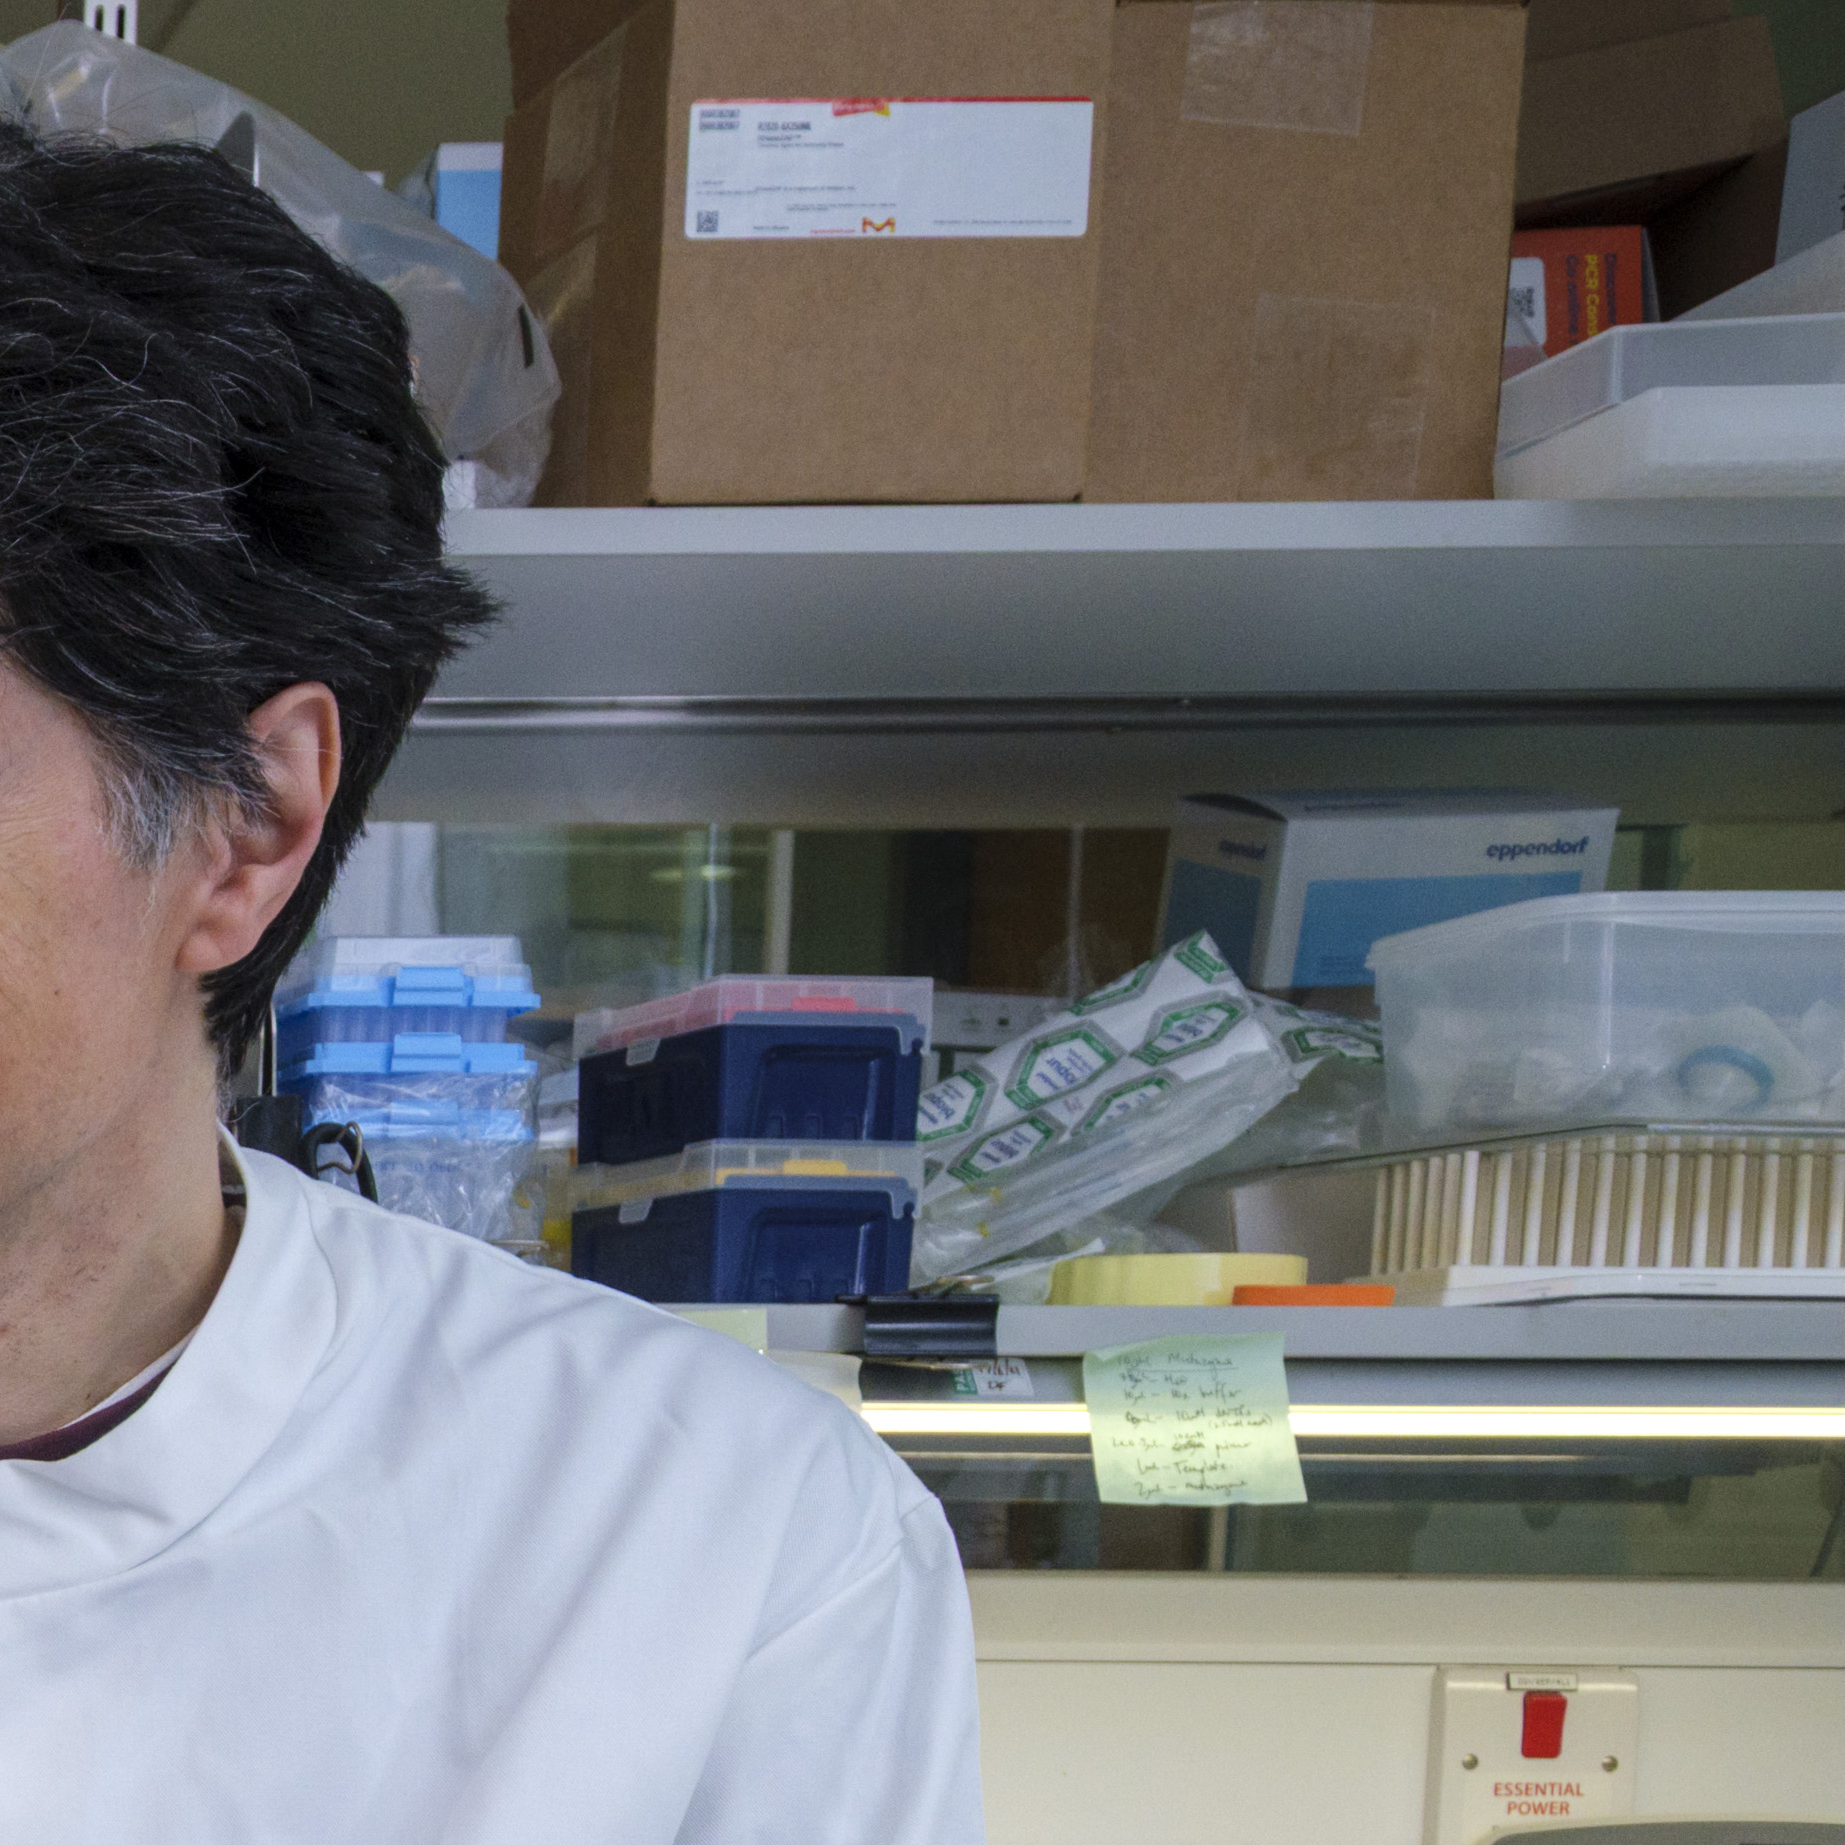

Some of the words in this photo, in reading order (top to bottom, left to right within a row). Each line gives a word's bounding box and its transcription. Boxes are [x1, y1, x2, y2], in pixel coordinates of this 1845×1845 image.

[1486, 836, 1590, 861] eppendorf
[1493, 1782, 1584, 1797] ESSENTIAL
[1507, 1801, 1570, 1816] POWER
